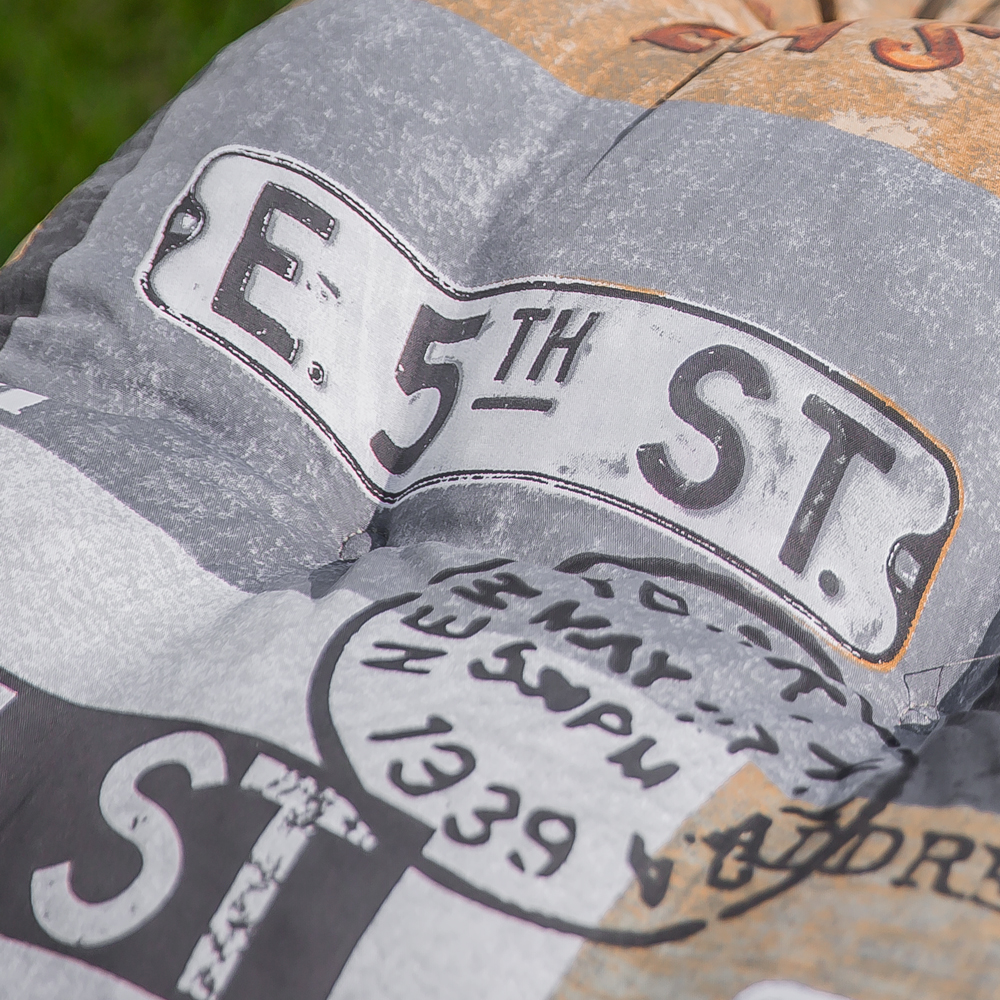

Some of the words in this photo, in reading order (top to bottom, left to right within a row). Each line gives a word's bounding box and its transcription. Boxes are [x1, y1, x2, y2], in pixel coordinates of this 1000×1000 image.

[370, 304, 601, 476] 5TH
[636, 343, 896, 600] ST.
[30, 730, 377, 1000] ST
